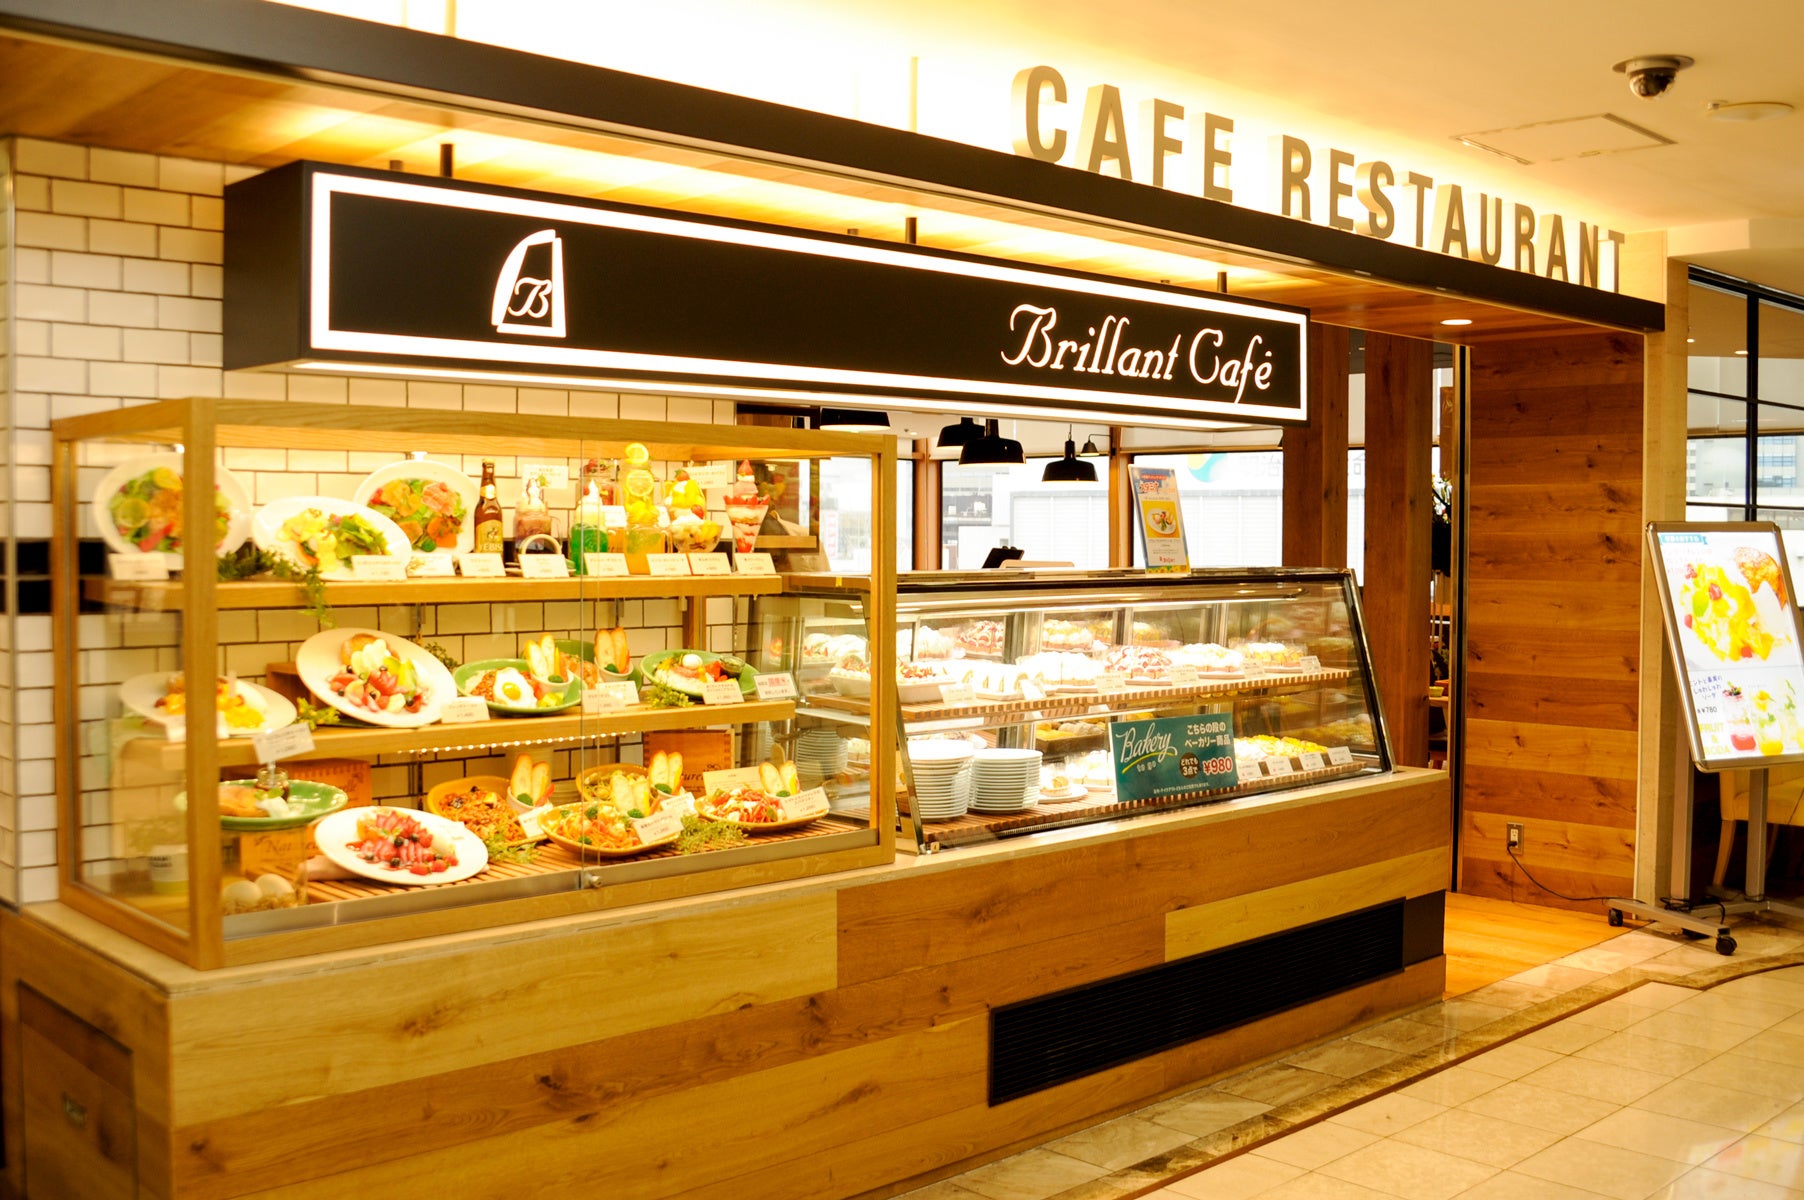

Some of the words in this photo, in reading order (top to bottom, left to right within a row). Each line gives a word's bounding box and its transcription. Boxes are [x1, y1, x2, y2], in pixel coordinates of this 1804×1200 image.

[1013, 65, 1234, 204] CAFE
[1272, 134, 1625, 294] RESTAURANT
[1000, 303, 1182, 381] Brillant
[1189, 328, 1273, 405] Café
[1115, 722, 1178, 763] Bakery
[1184, 734, 1231, 748] ベーカリー商品
[1187, 721, 1226, 735] こちらの段の
[1202, 756, 1234, 776] ¥980
